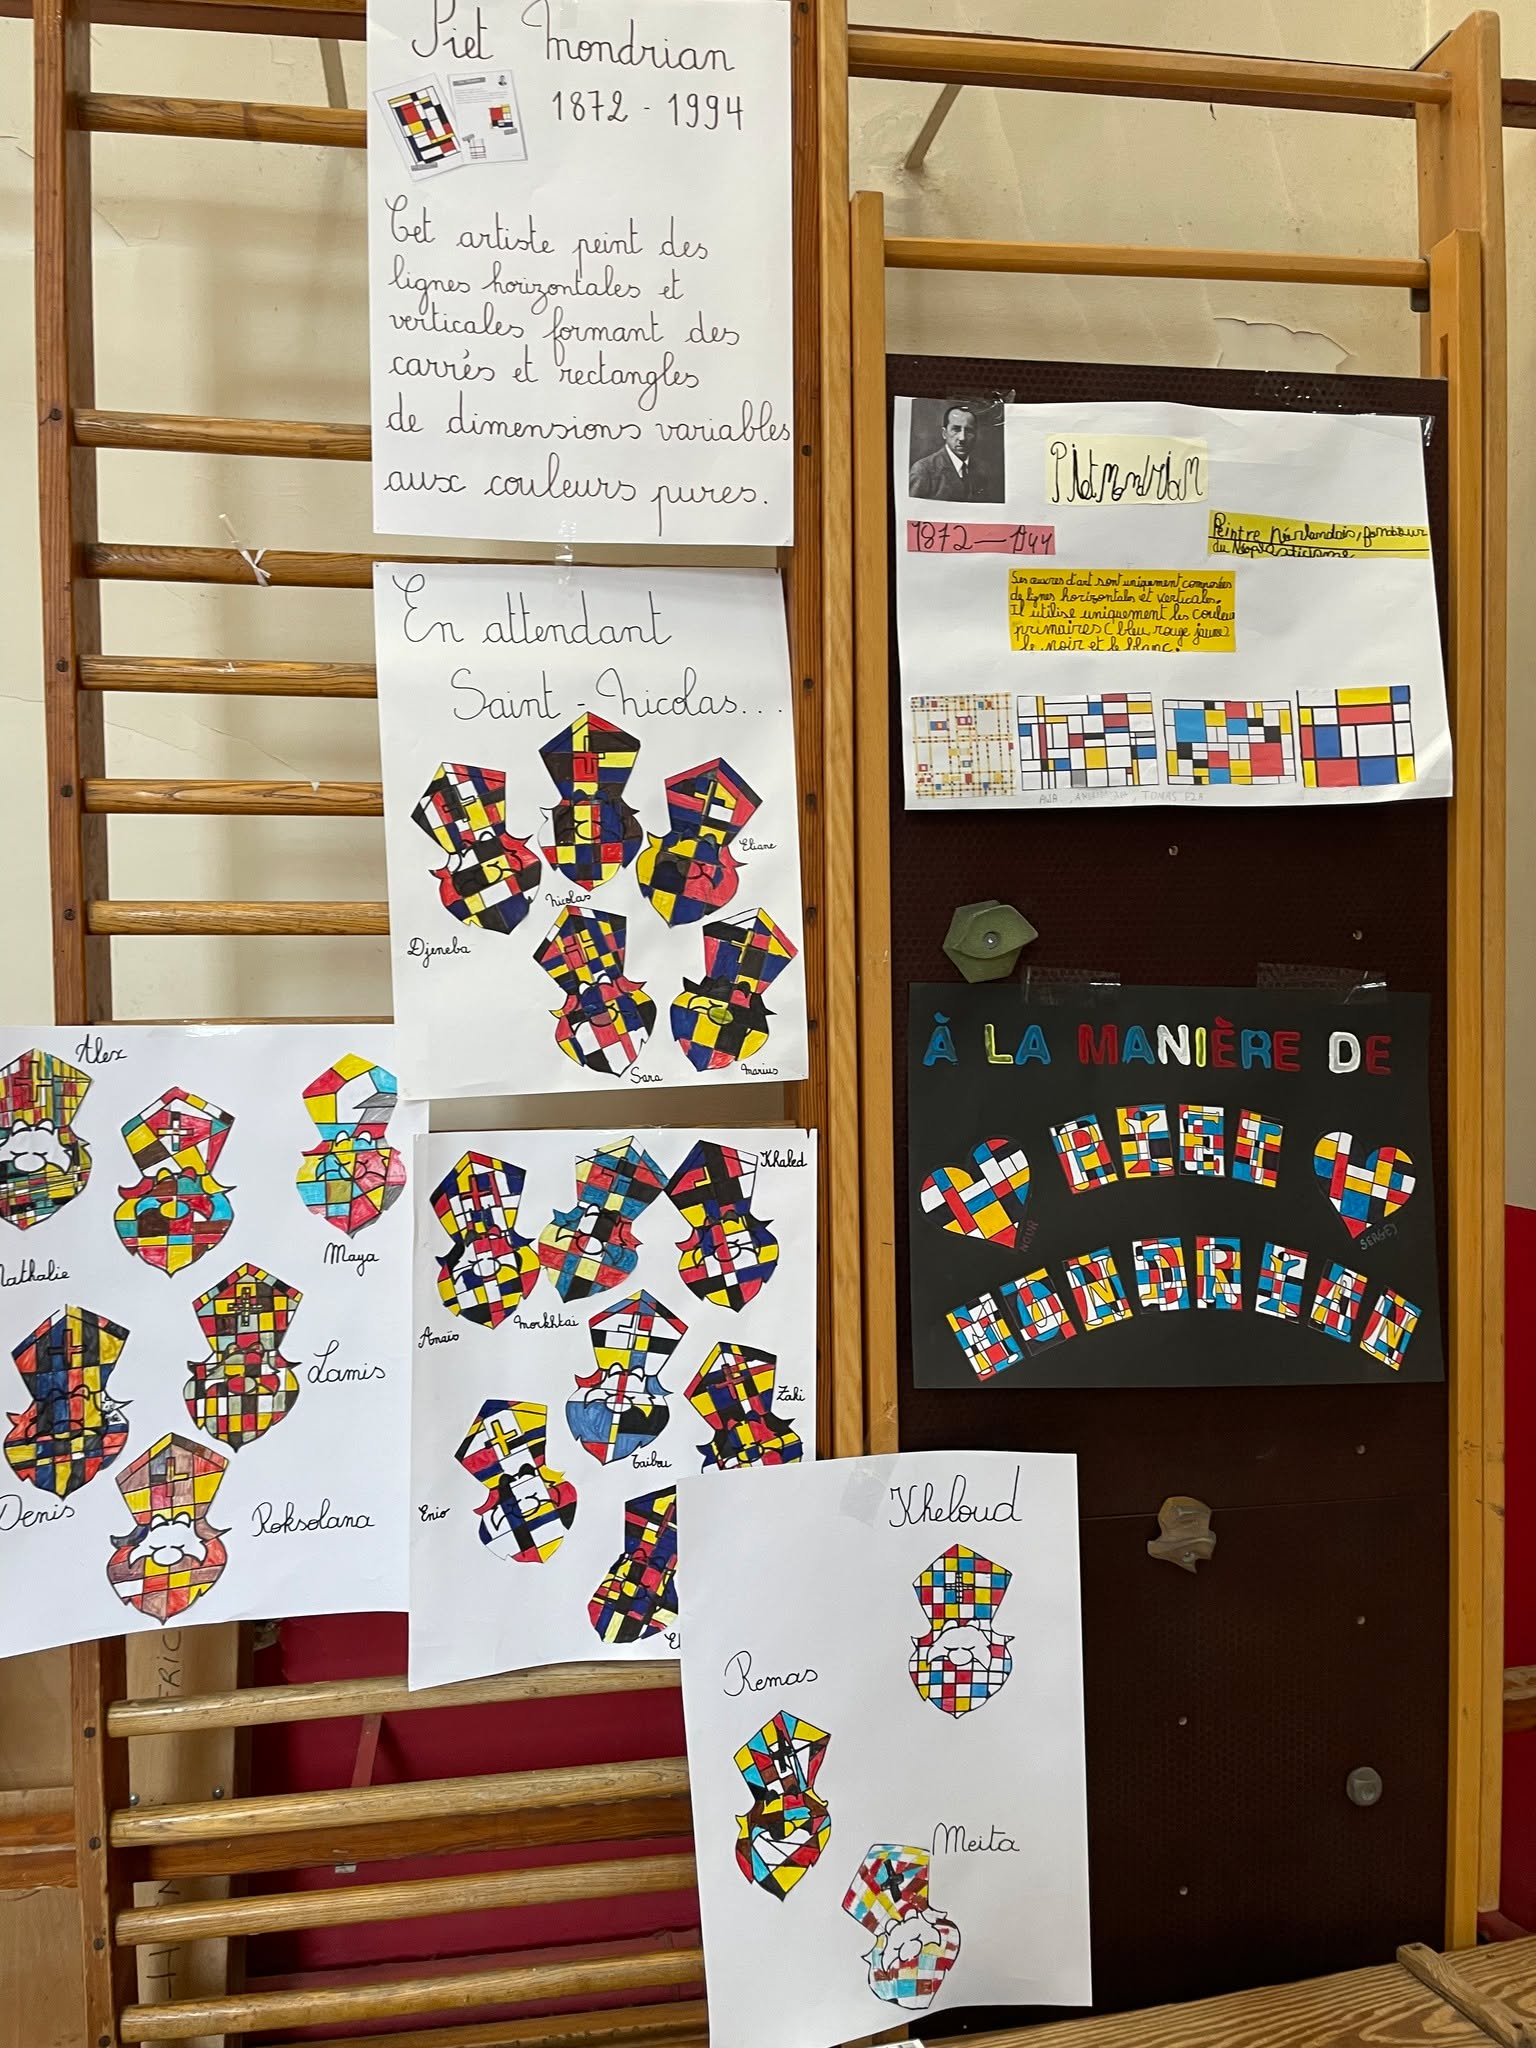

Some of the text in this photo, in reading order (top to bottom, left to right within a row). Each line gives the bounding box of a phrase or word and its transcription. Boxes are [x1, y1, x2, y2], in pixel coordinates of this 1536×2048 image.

[411, 0, 494, 60] Piet
[552, 90, 628, 123] 1872
[667, 92, 744, 130] 1994
[384, 194, 709, 278] Cet artiste peint des
[388, 255, 684, 315] lignes horizontales et
[389, 301, 740, 367] verticales formant des
[388, 344, 700, 411] carrés et rectangles
[386, 390, 791, 443] de dimensions variables
[384, 452, 768, 537] aux couleurs pures.
[1213, 512, 1261, 542] Peintre
[1213, 540, 1230, 553] du
[1011, 570, 1028, 585] Ses
[1094, 572, 1122, 588] sont
[1139, 587, 1154, 603] et
[392, 573, 673, 645] En attendant
[1029, 602, 1077, 618] utilise
[1080, 604, 1168, 624] uniquement
[1169, 603, 1190, 621] les
[1014, 620, 1102, 642] primaires
[1153, 626, 1190, 647] rouge
[1041, 636, 1084, 651] noir
[1088, 636, 1105, 651] et
[407, 936, 471, 968] Djeneba
[75, 1033, 128, 1064] Alex
[923, 1011, 1393, 1075] À LA MANIÈRE DE
[630, 1066, 664, 1083] Sara
[760, 1150, 808, 1169] Khaled
[1052, 1104, 1284, 1193] PIET
[323, 1242, 380, 1277] Maya
[946, 1236, 1422, 1381] MONDRIAN
[307, 1339, 386, 1384] Lamis
[776, 1385, 806, 1402] Zaki
[0, 1494, 76, 1532] Denis
[418, 1504, 451, 1522] Enio
[888, 1464, 1023, 1528] Kheloud
[251, 1498, 376, 1538] Roksolana
[723, 1650, 819, 1697] Remas
[932, 1822, 1021, 1856] Meita
